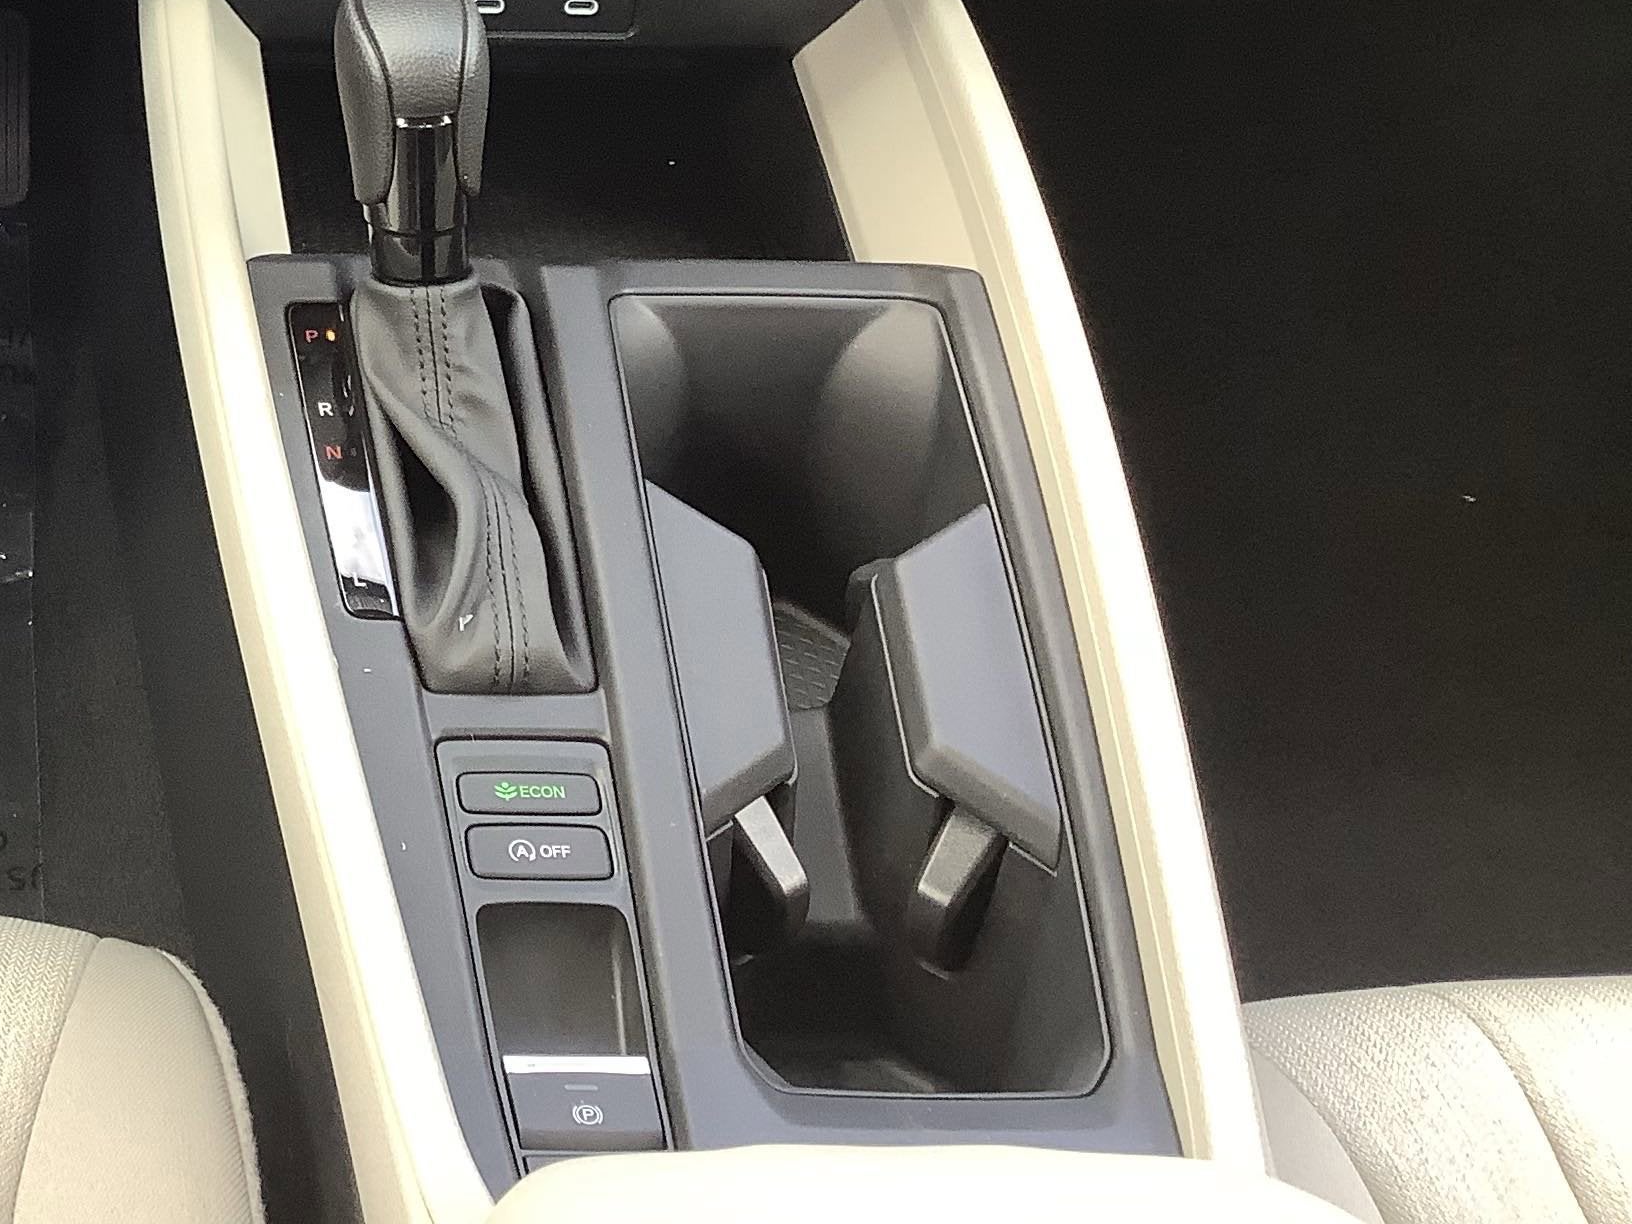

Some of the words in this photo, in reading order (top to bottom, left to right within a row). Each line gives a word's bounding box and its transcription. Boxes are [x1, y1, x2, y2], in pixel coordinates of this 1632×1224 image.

[304, 329, 319, 344] P
[317, 401, 334, 418] R
[325, 444, 343, 460] N
[519, 784, 567, 799] ECON
[539, 844, 571, 858] OFF
